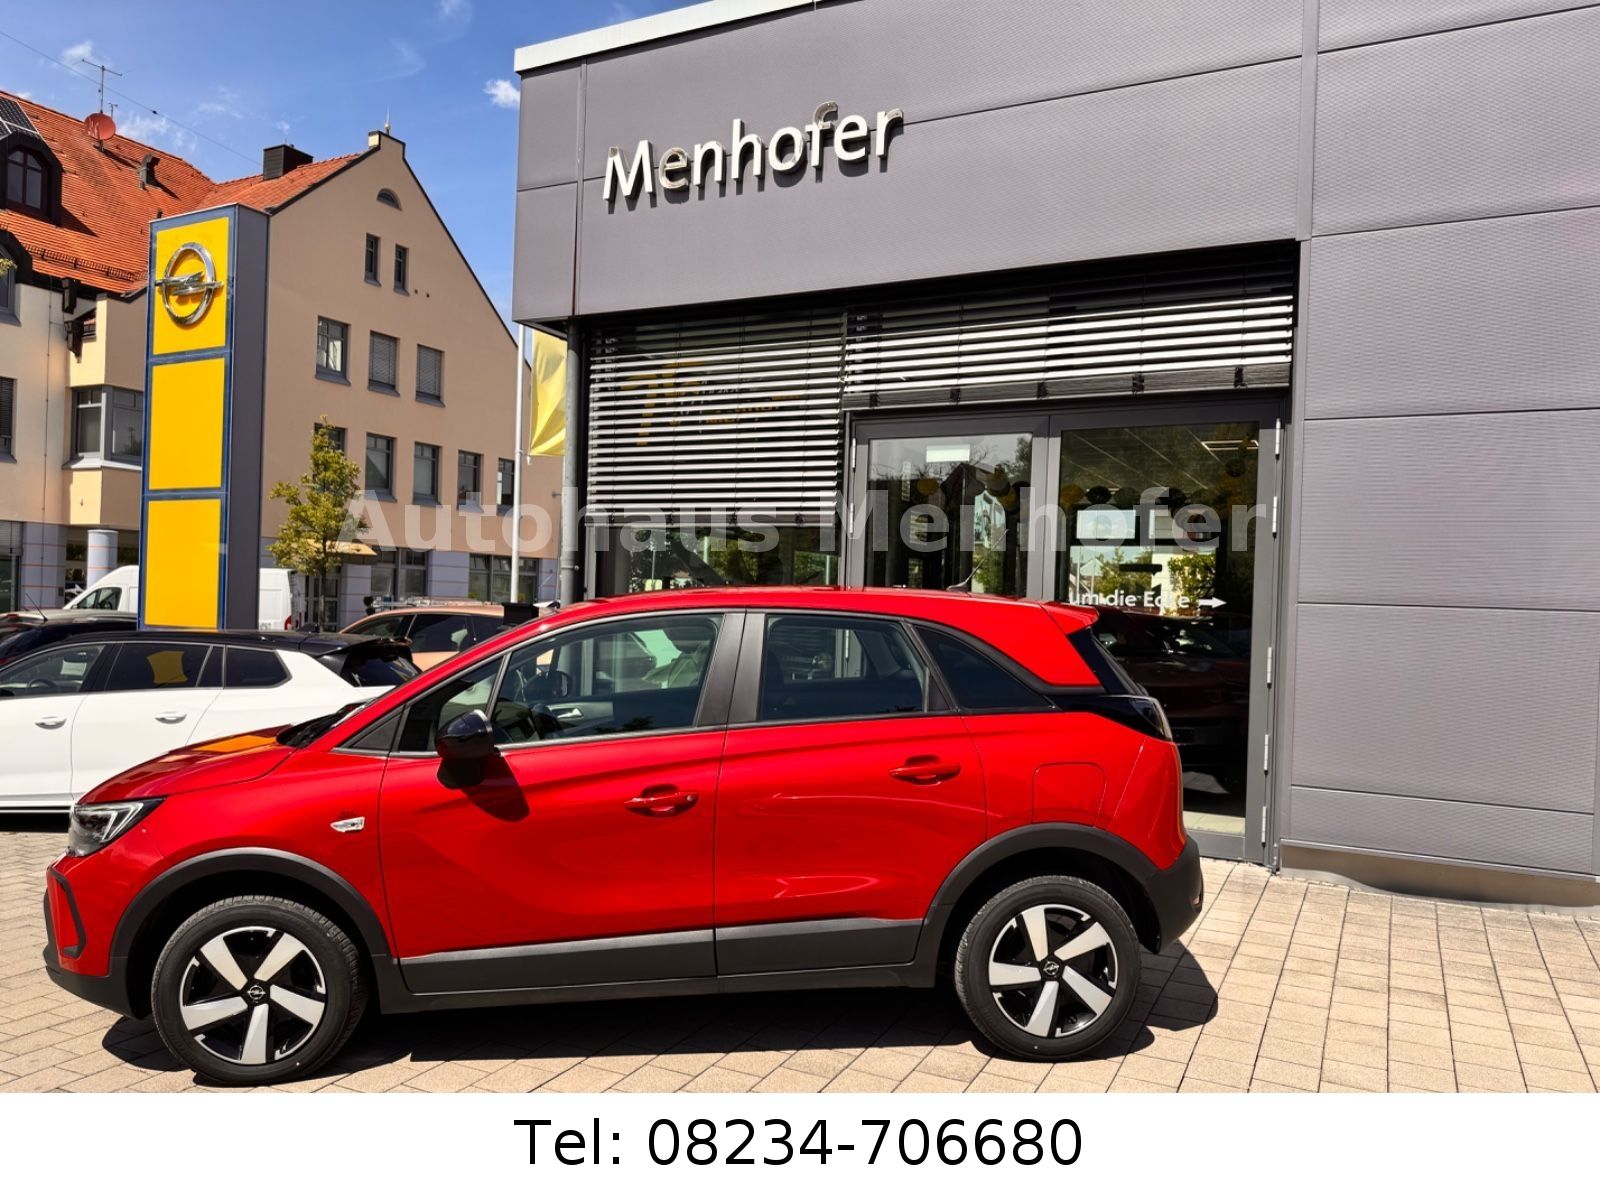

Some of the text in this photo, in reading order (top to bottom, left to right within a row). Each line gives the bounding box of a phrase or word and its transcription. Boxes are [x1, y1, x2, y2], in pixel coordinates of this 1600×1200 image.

[602, 100, 904, 201] Menhofer
[1107, 589, 1136, 607] die
[1143, 590, 1190, 608] Ece
